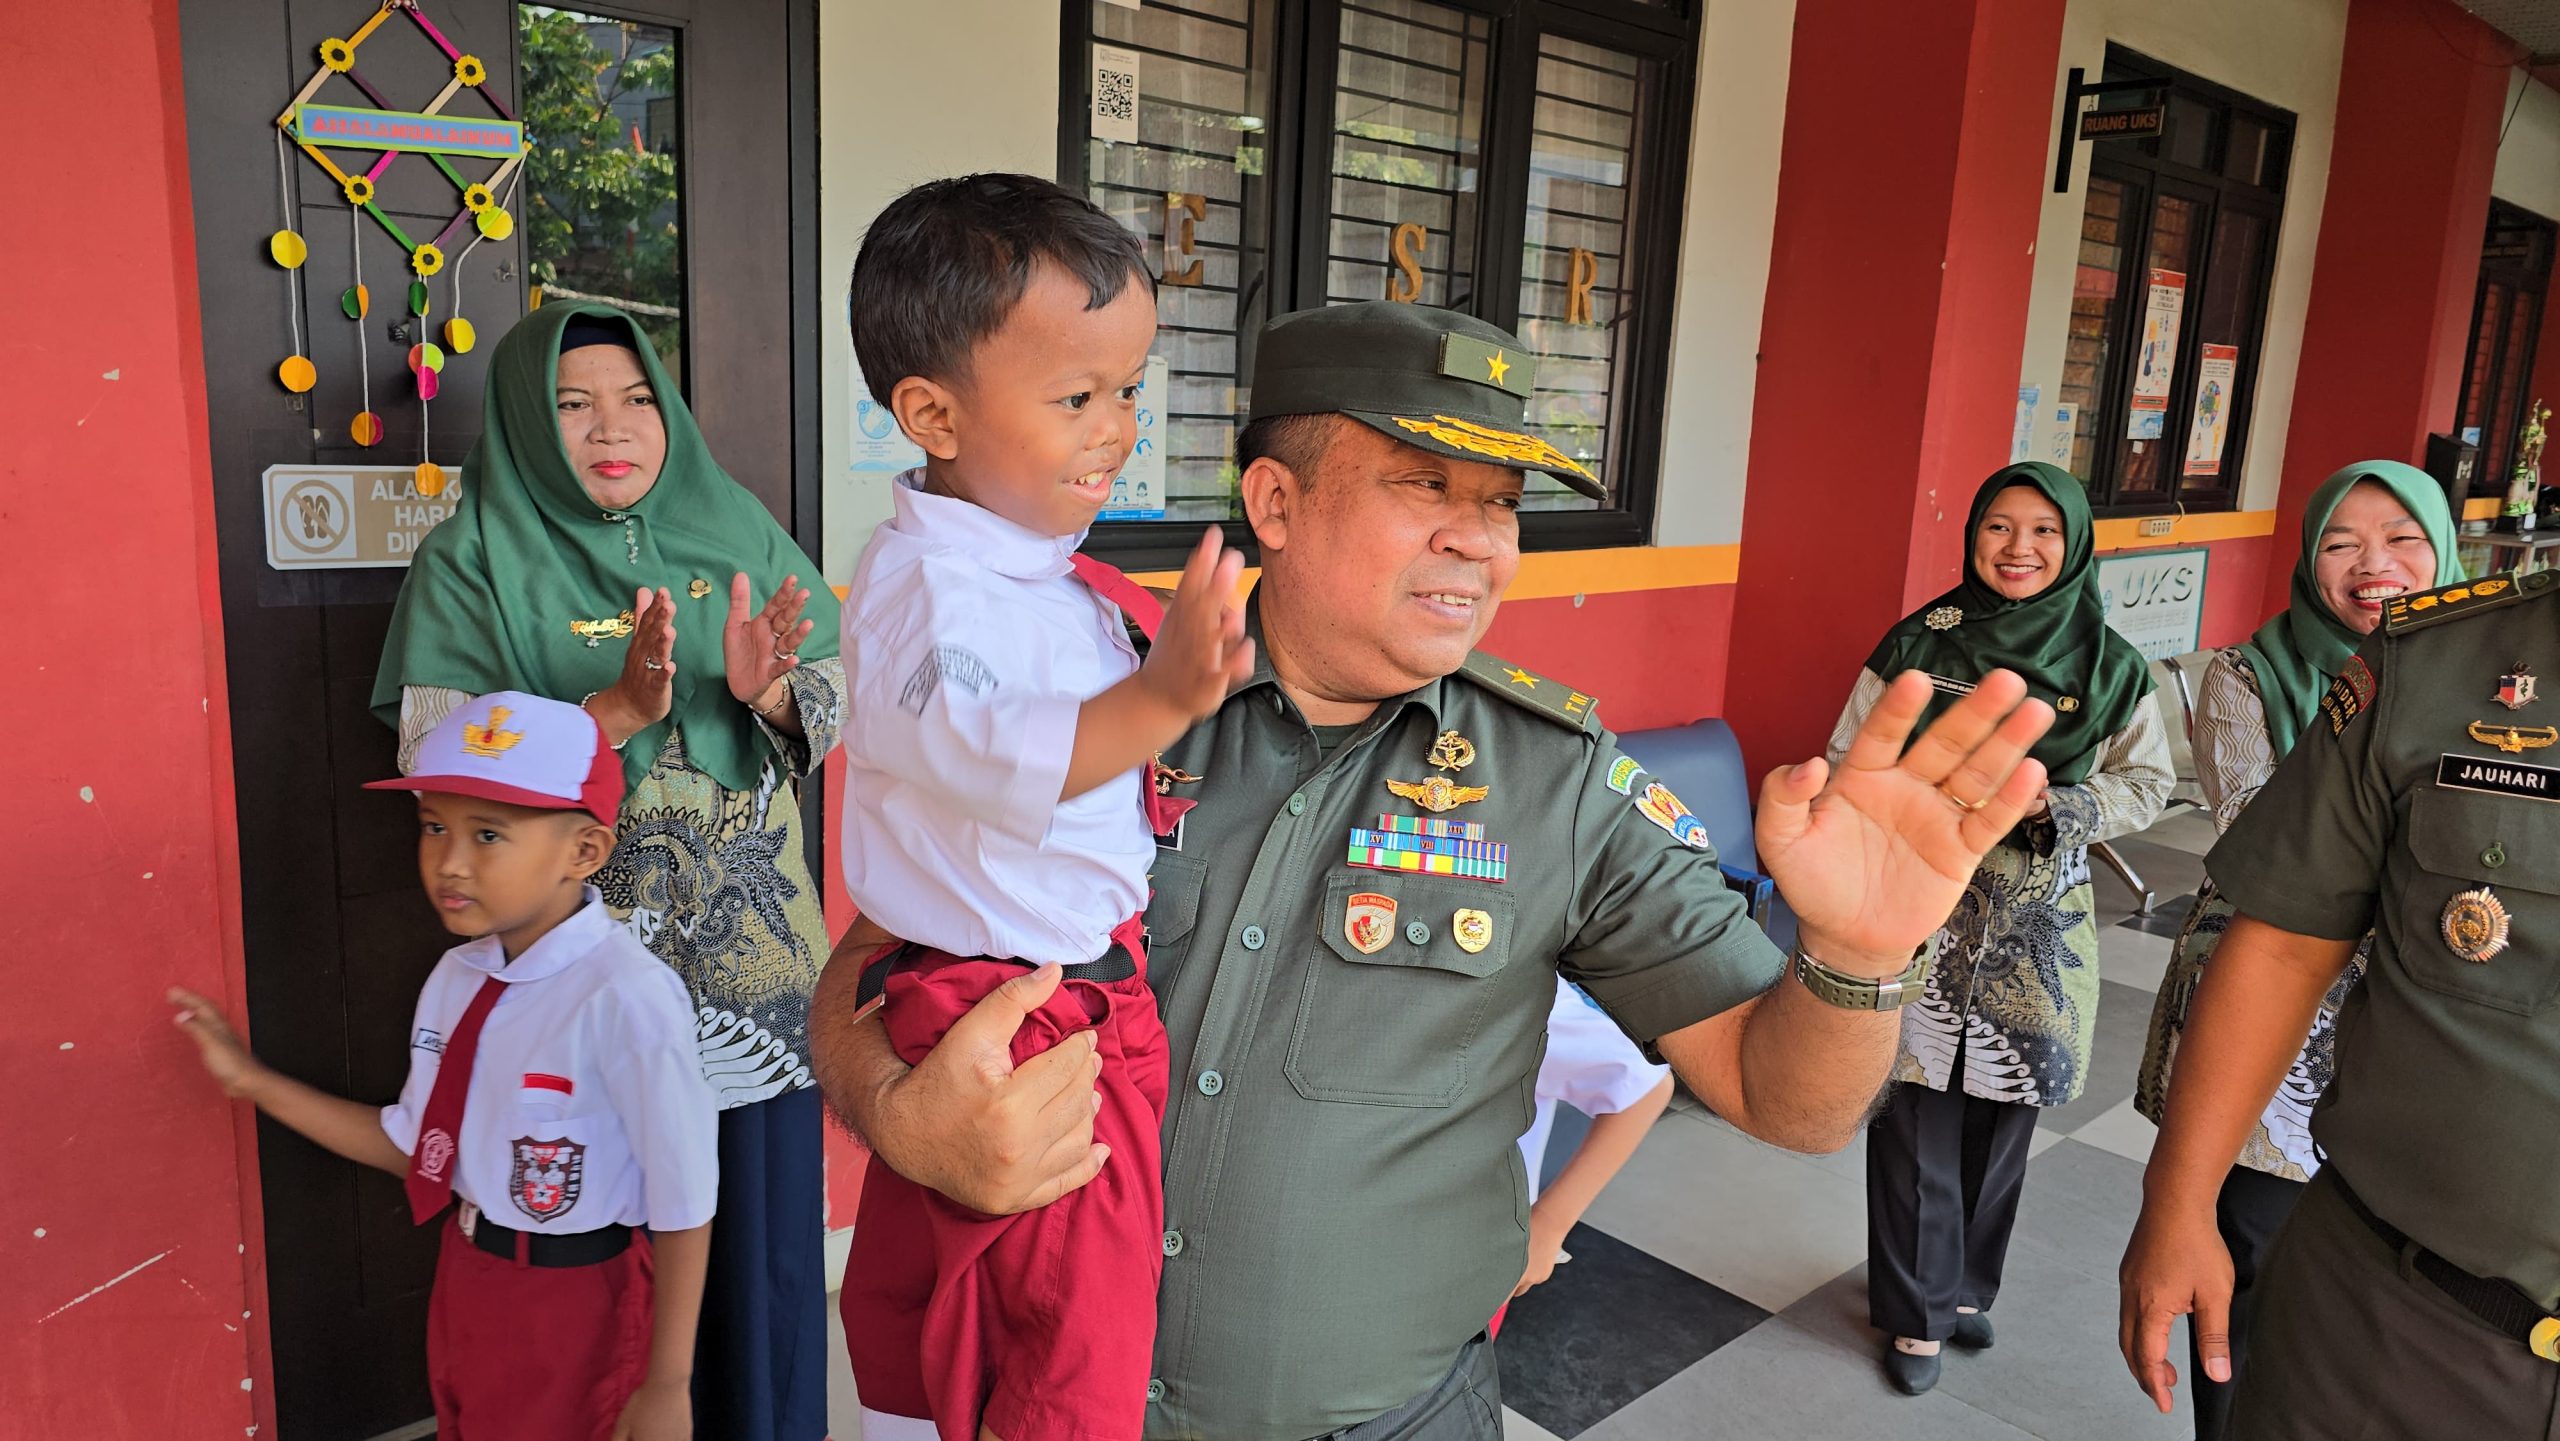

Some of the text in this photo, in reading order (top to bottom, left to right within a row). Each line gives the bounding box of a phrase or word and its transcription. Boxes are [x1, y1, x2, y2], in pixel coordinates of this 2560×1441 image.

[2084, 112, 2157, 131] RUANG UKS
[1565, 246, 1598, 325] R
[371, 479, 433, 500] ALA
[2122, 565, 2193, 609] UKS
[2389, 597, 2409, 623] TNI
[1565, 691, 1590, 713] TNI
[2460, 765, 2547, 789] JAUHARI
[1370, 833, 1384, 845] XVI
[1448, 825, 1465, 835] XXIV
